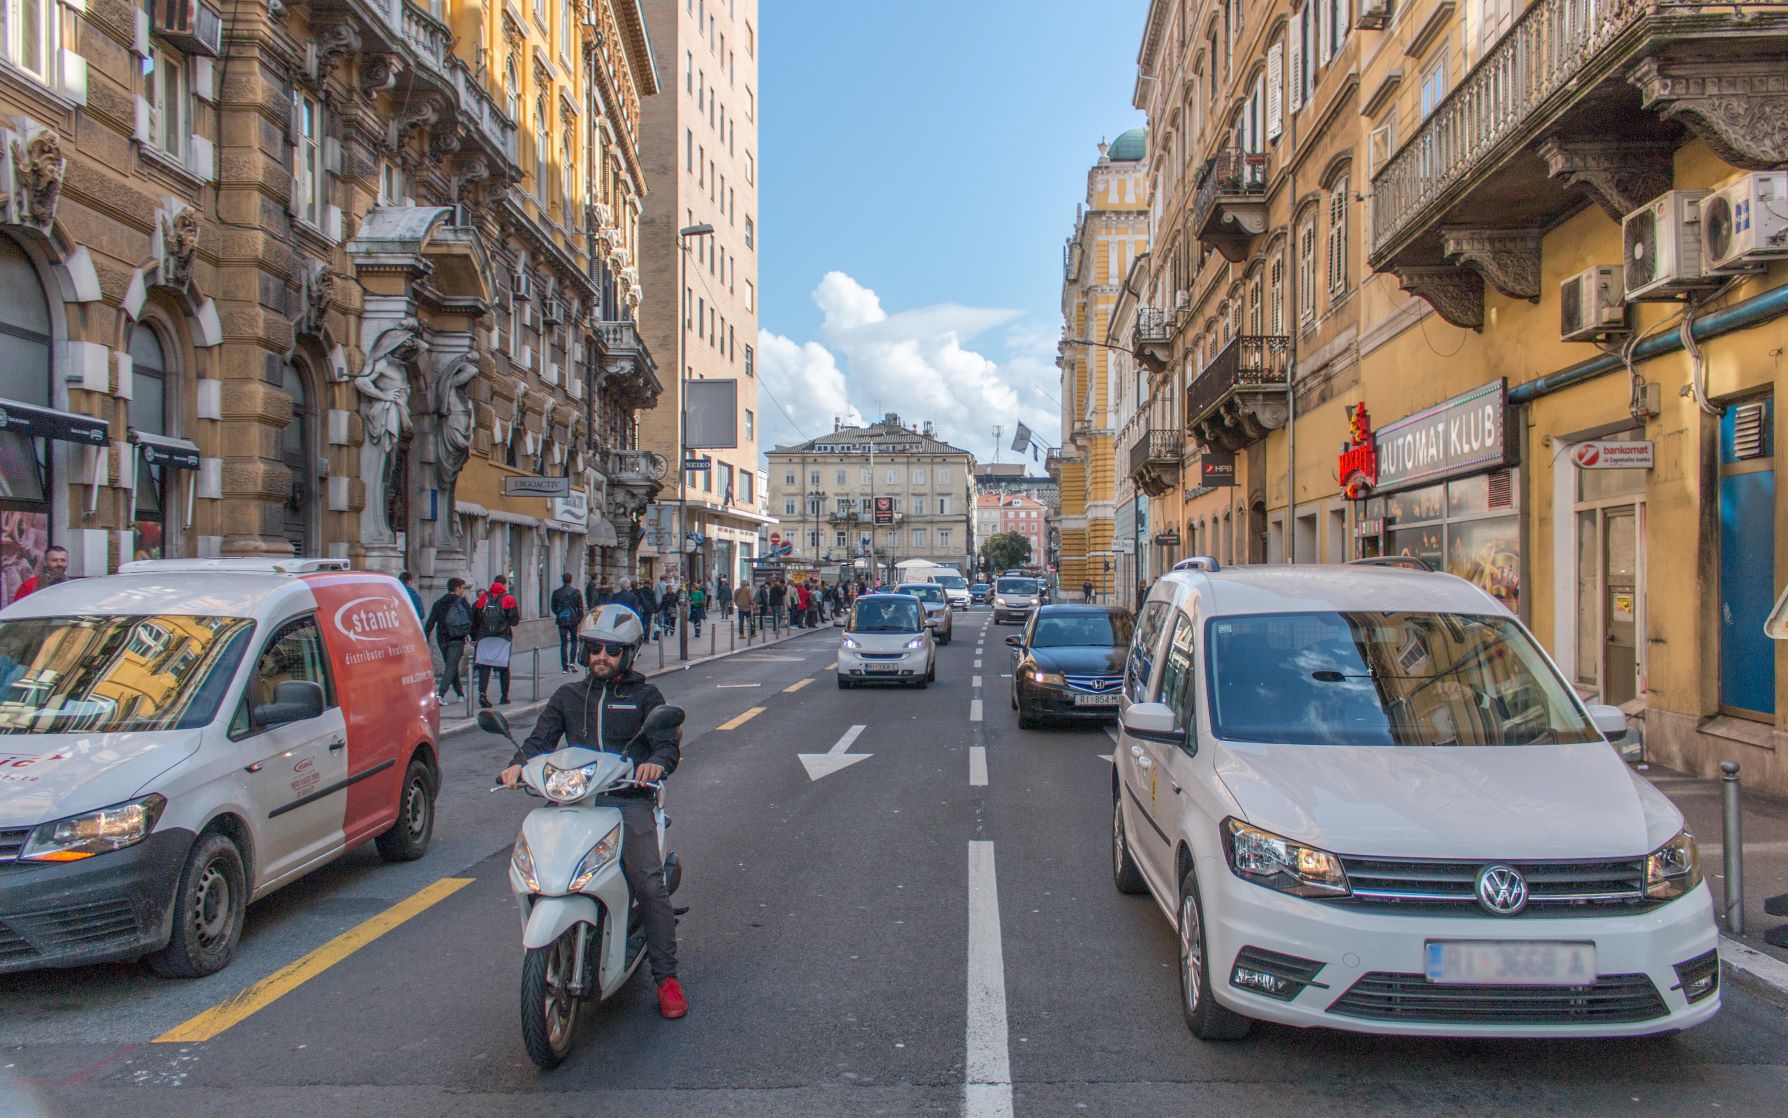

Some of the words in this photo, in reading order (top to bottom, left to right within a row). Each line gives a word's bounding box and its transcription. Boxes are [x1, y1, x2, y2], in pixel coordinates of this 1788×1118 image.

[1380, 423, 1444, 476] AUTOMAT
[1450, 404, 1495, 457] KLUB
[1603, 446, 1649, 455] bankomat
[686, 460, 711, 469] SEIKO
[514, 480, 561, 489] ERGOACTIV
[352, 604, 400, 633] stanić
[1080, 695, 1089, 704] RI
